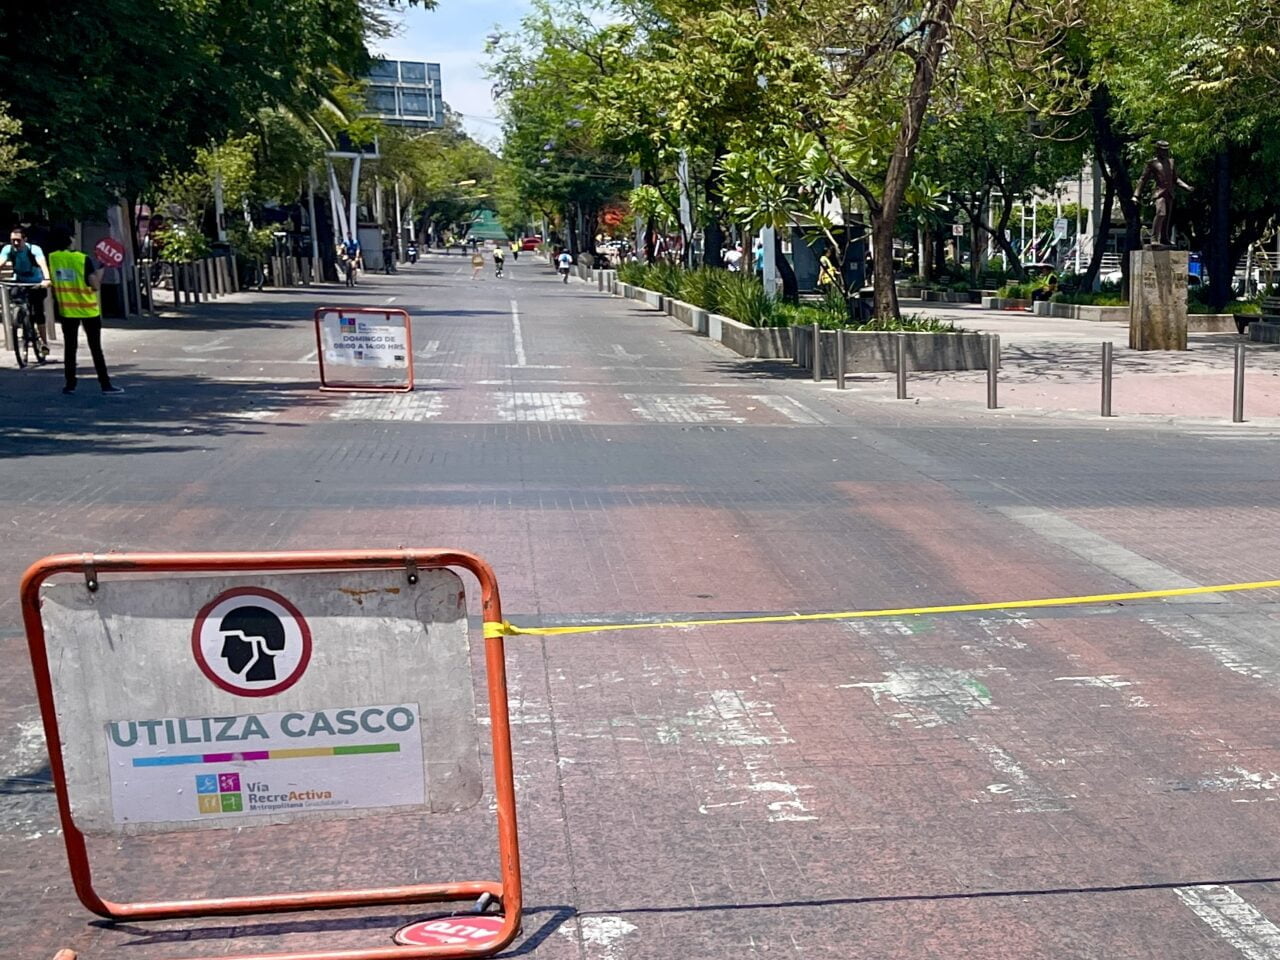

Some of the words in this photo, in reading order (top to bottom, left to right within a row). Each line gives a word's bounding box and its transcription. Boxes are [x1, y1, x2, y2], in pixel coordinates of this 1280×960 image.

[96, 241, 123, 262] ALTO
[343, 335, 382, 343] DOMINGO
[110, 715, 270, 747] UTILIZA
[280, 706, 415, 738] CASCO
[247, 781, 269, 792] Vía
[248, 789, 332, 804] RecreActiva
[249, 802, 303, 812] Metropolitana
[424, 922, 499, 938] ALTO
